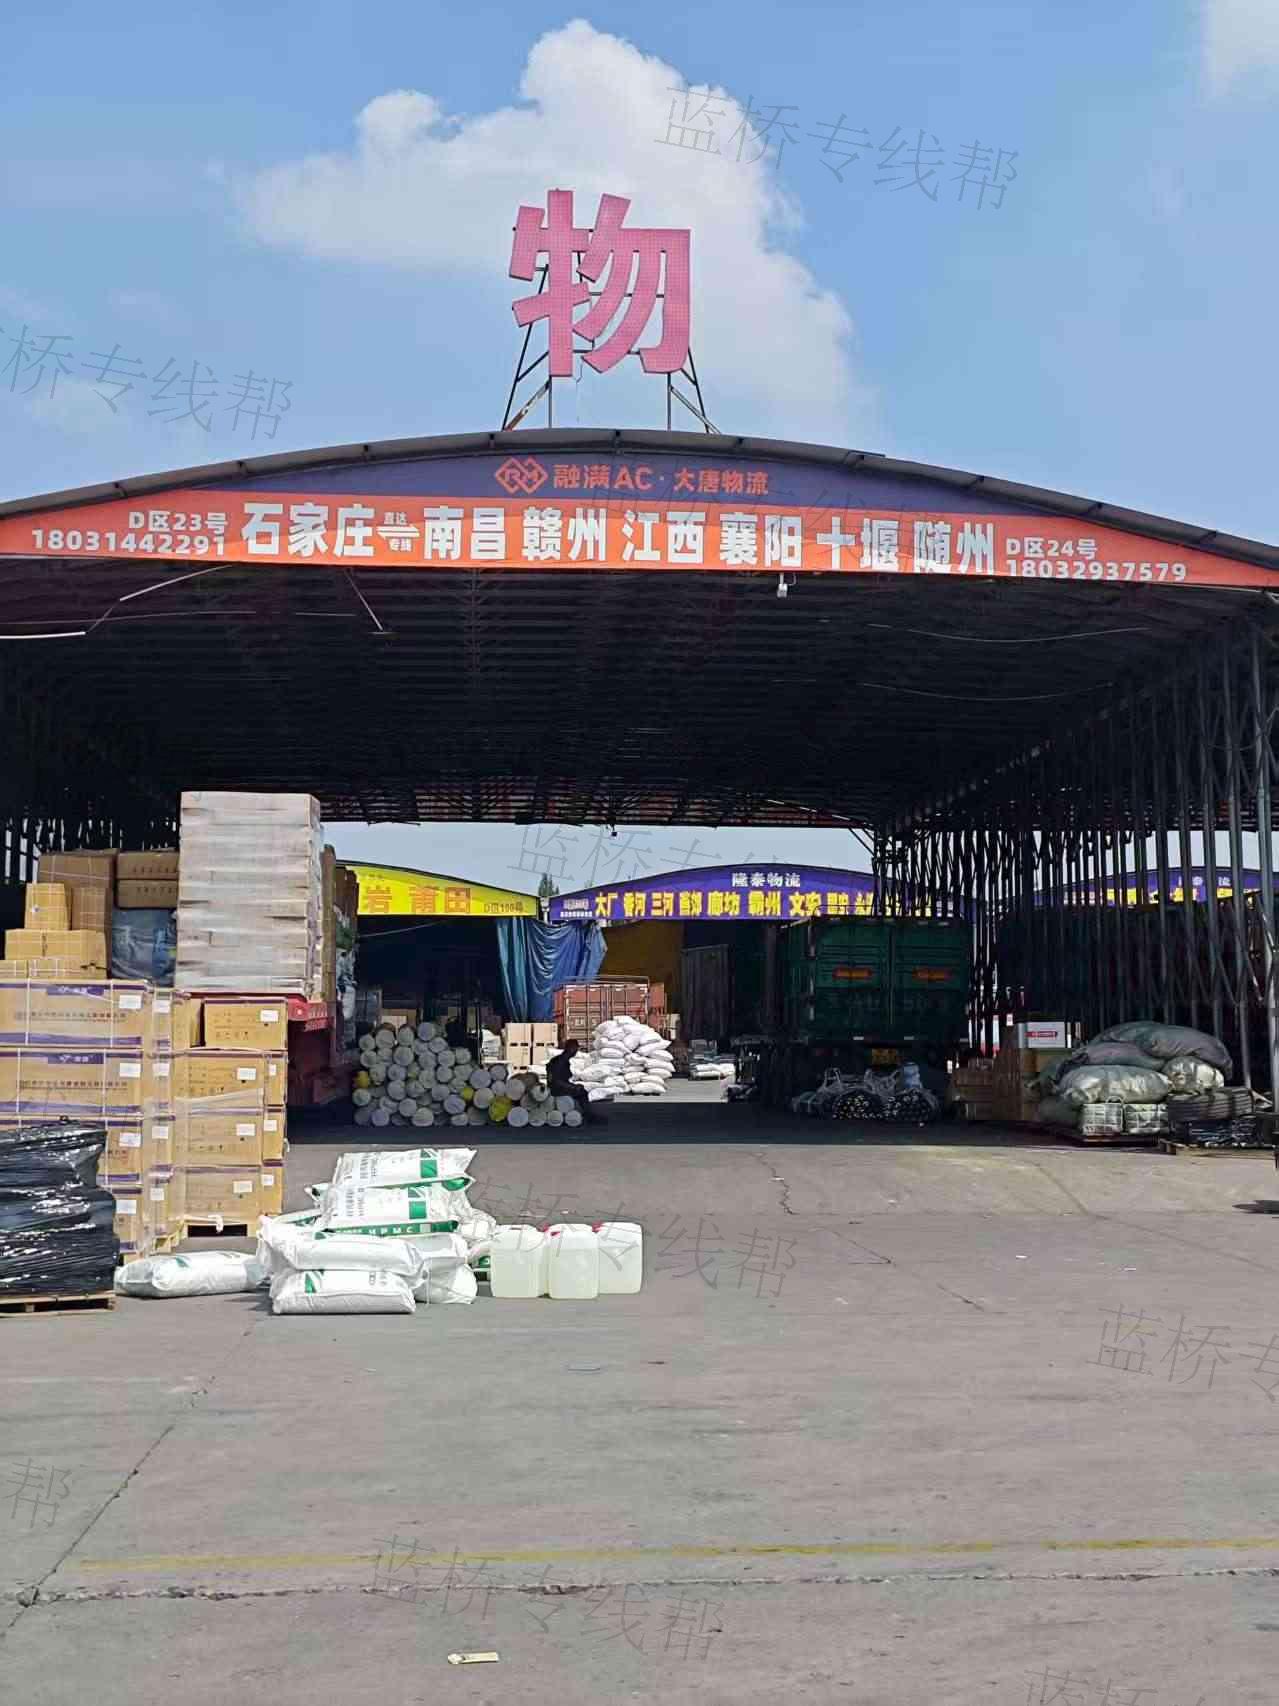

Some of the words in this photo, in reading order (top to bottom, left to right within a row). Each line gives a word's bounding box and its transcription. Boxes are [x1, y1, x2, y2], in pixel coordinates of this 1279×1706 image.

[509, 188, 691, 377] 物
[128, 510, 228, 534] D区23号
[31, 528, 225, 556] 18031442291
[241, 503, 375, 558] 石家庄
[423, 505, 506, 561] 南昌
[521, 507, 607, 561] 赣州
[622, 509, 706, 564] 江西
[719, 511, 803, 568] 襄阳
[816, 516, 899, 571] 十堰
[913, 520, 994, 574] 随州
[1006, 537, 1098, 560] D区24号
[1006, 559, 1187, 582] 18032937579
